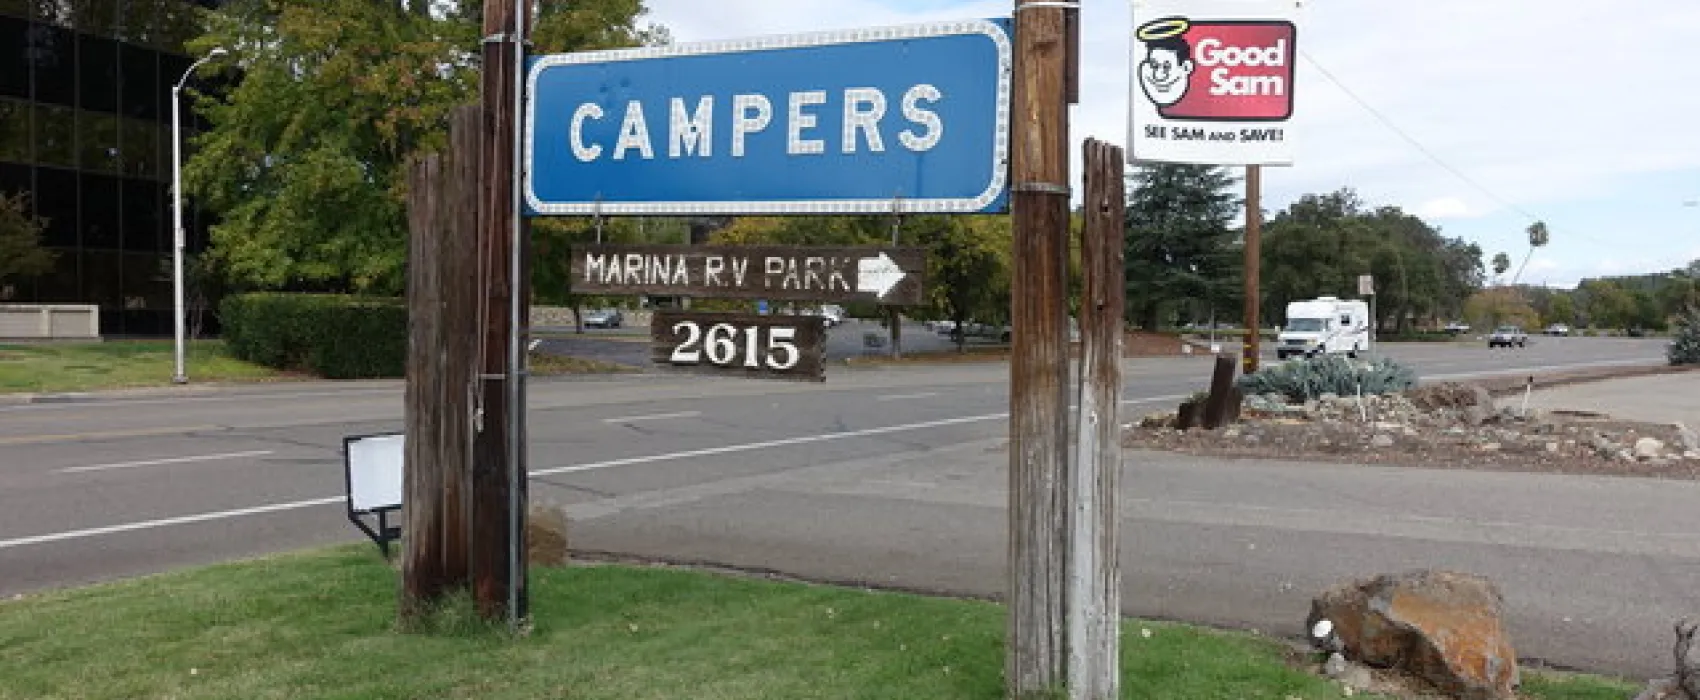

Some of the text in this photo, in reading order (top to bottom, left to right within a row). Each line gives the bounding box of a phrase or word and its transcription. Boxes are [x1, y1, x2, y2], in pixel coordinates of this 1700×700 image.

[1195, 38, 1286, 67] Good
[1209, 68, 1284, 96] Sam
[569, 84, 943, 162] CAMPERS
[1144, 124, 1284, 143] SEE SAM AND SAVE!
[586, 253, 689, 287] MARINA
[764, 256, 850, 292] PARK
[669, 321, 800, 370] 2615
